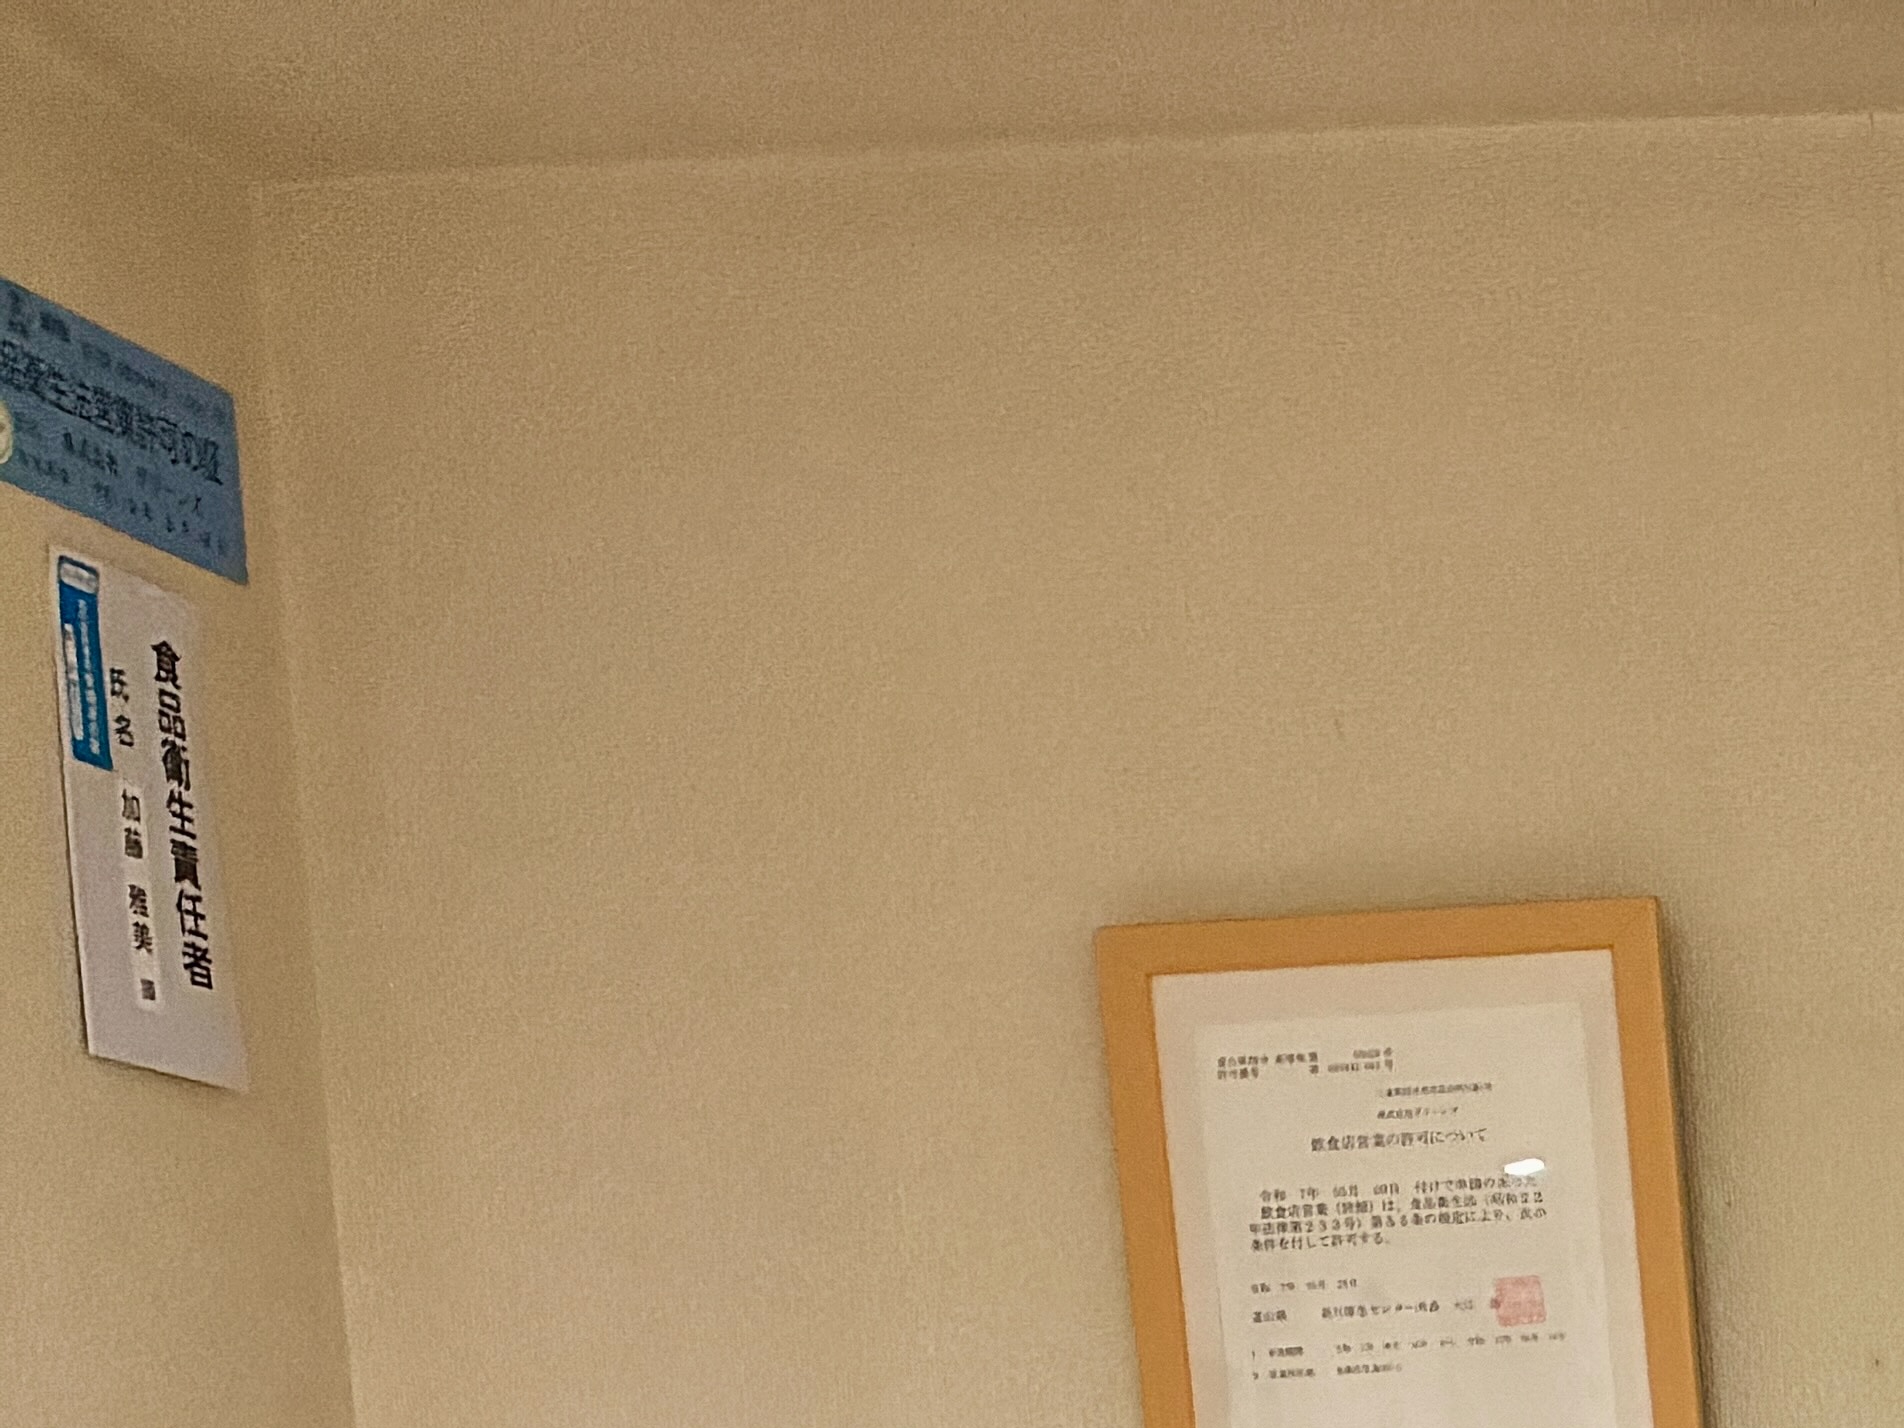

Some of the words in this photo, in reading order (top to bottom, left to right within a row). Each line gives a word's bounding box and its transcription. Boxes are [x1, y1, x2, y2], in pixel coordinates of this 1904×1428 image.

[151, 640, 214, 991] 食品衛生責任者
